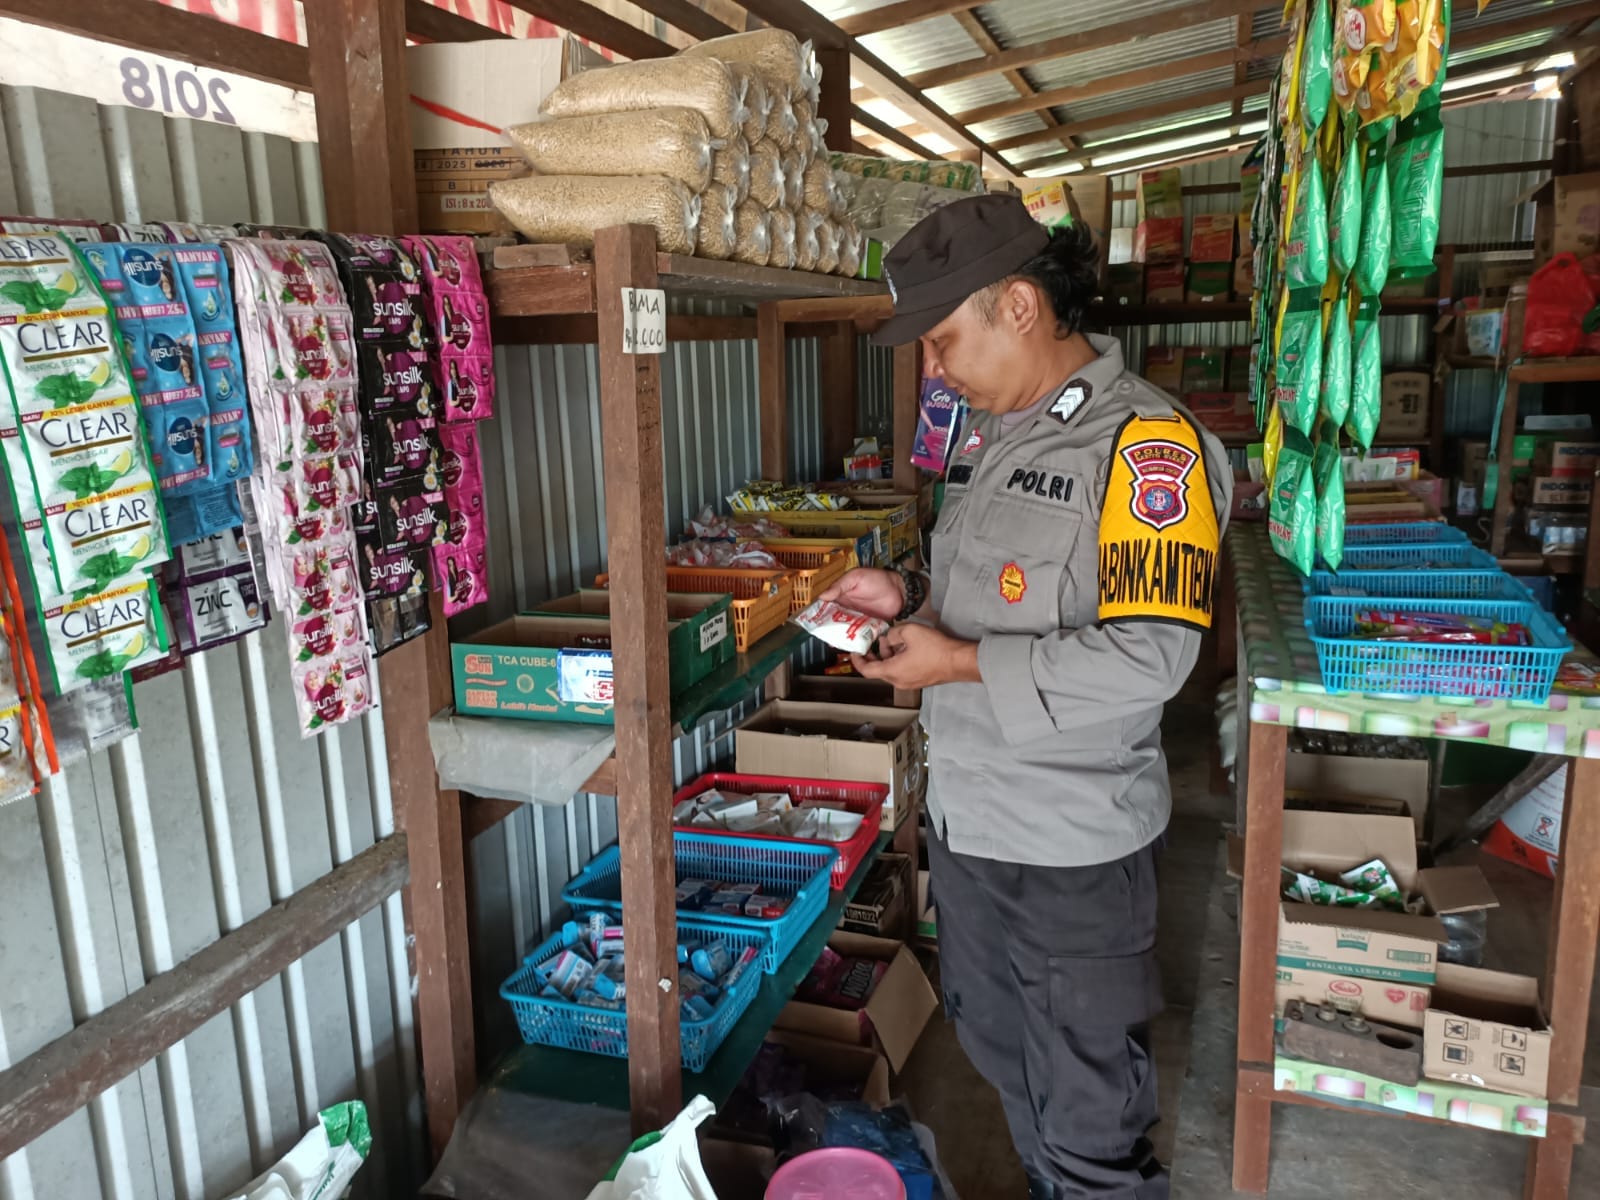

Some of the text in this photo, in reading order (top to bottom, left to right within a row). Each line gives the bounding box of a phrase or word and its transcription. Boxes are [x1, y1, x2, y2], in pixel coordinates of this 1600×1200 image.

[0, 239, 65, 259] LEAR
[373, 299, 415, 316] sunsilk
[17, 321, 107, 353] CLEAR
[382, 366, 423, 386] sunsilk
[40, 412, 131, 448] CLEAR
[1006, 468, 1074, 503] POLRI
[64, 498, 149, 538] CLEAR
[396, 507, 438, 532] sunsilk
[369, 557, 417, 580] sunsilk
[60, 598, 143, 639] CLEAR
[497, 655, 517, 666] TCA
